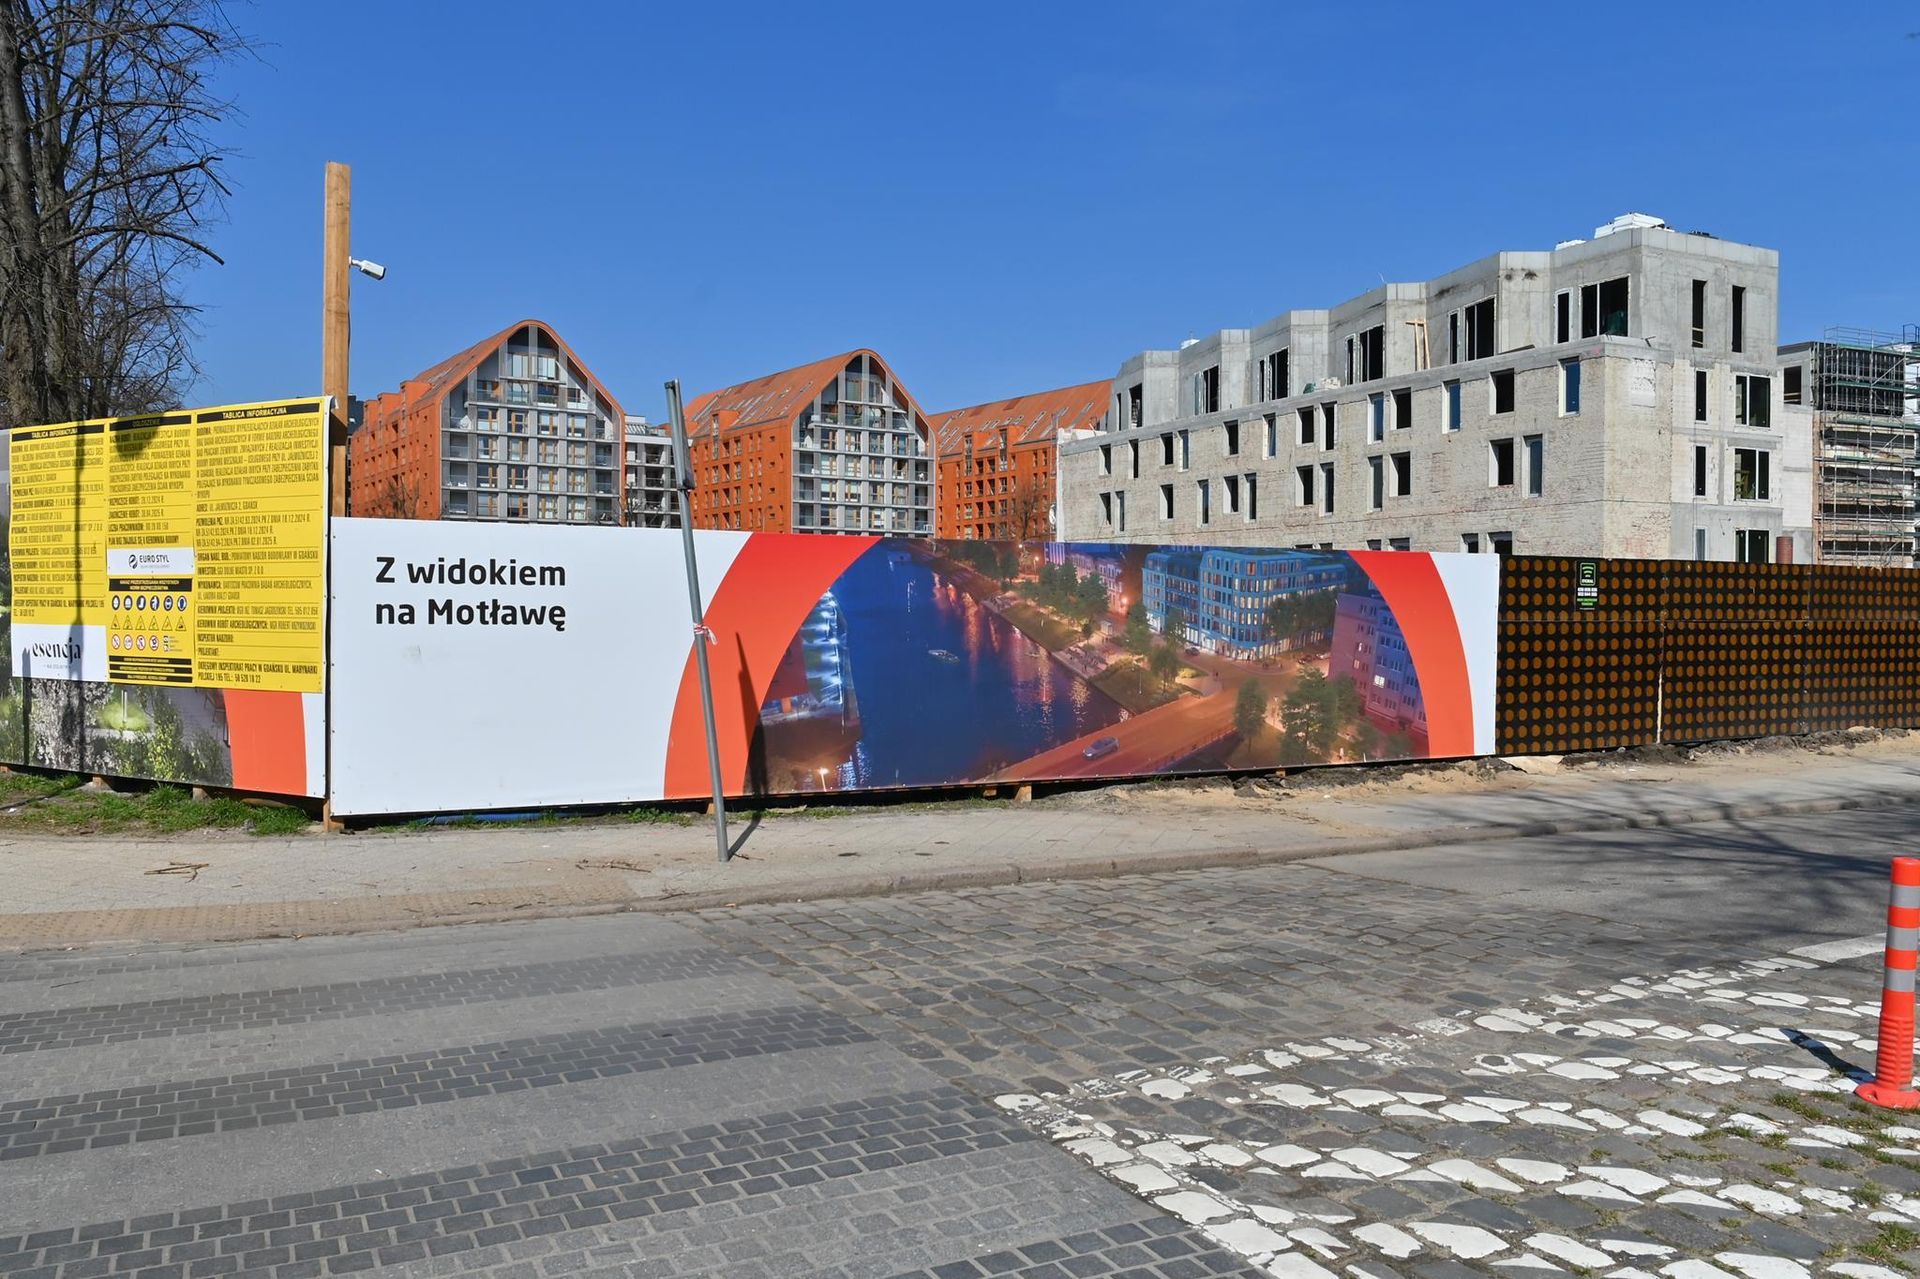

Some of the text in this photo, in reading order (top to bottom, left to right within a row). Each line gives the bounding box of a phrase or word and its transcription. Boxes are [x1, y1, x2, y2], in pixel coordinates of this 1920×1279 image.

[222, 407, 287, 419] TABLICA INFORMACYJNA
[376, 557, 565, 586] Z widokiem
[376, 599, 565, 631] na Motławę
[32, 637, 81, 664] esencja
